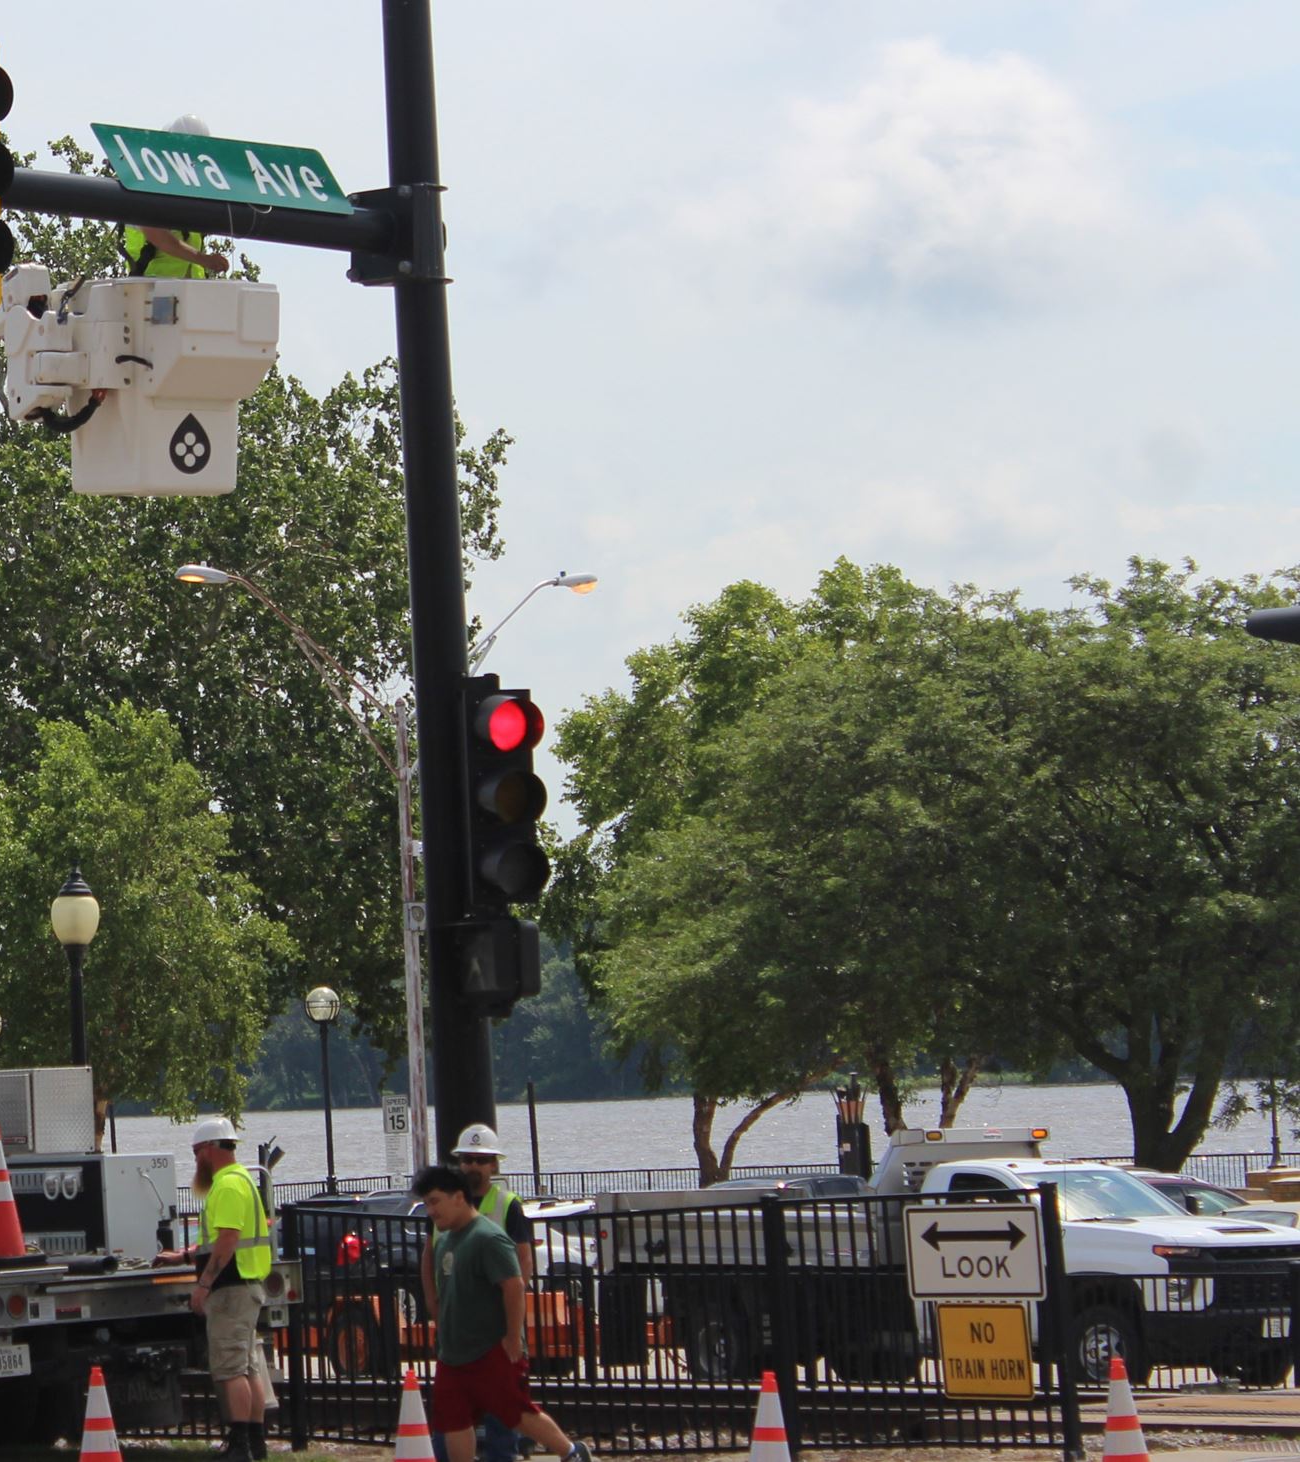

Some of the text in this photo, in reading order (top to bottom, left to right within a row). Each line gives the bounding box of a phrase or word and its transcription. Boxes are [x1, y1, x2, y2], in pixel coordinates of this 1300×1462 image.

[112, 133, 329, 202] Iowa Ave
[387, 1106, 405, 1114] LIMIT
[389, 1114, 406, 1131] 15
[150, 1157, 169, 1169] 350
[940, 1255, 1012, 1279] LOOK
[969, 1321, 996, 1344] NO
[948, 1357, 1026, 1381] TRAIN HORN
